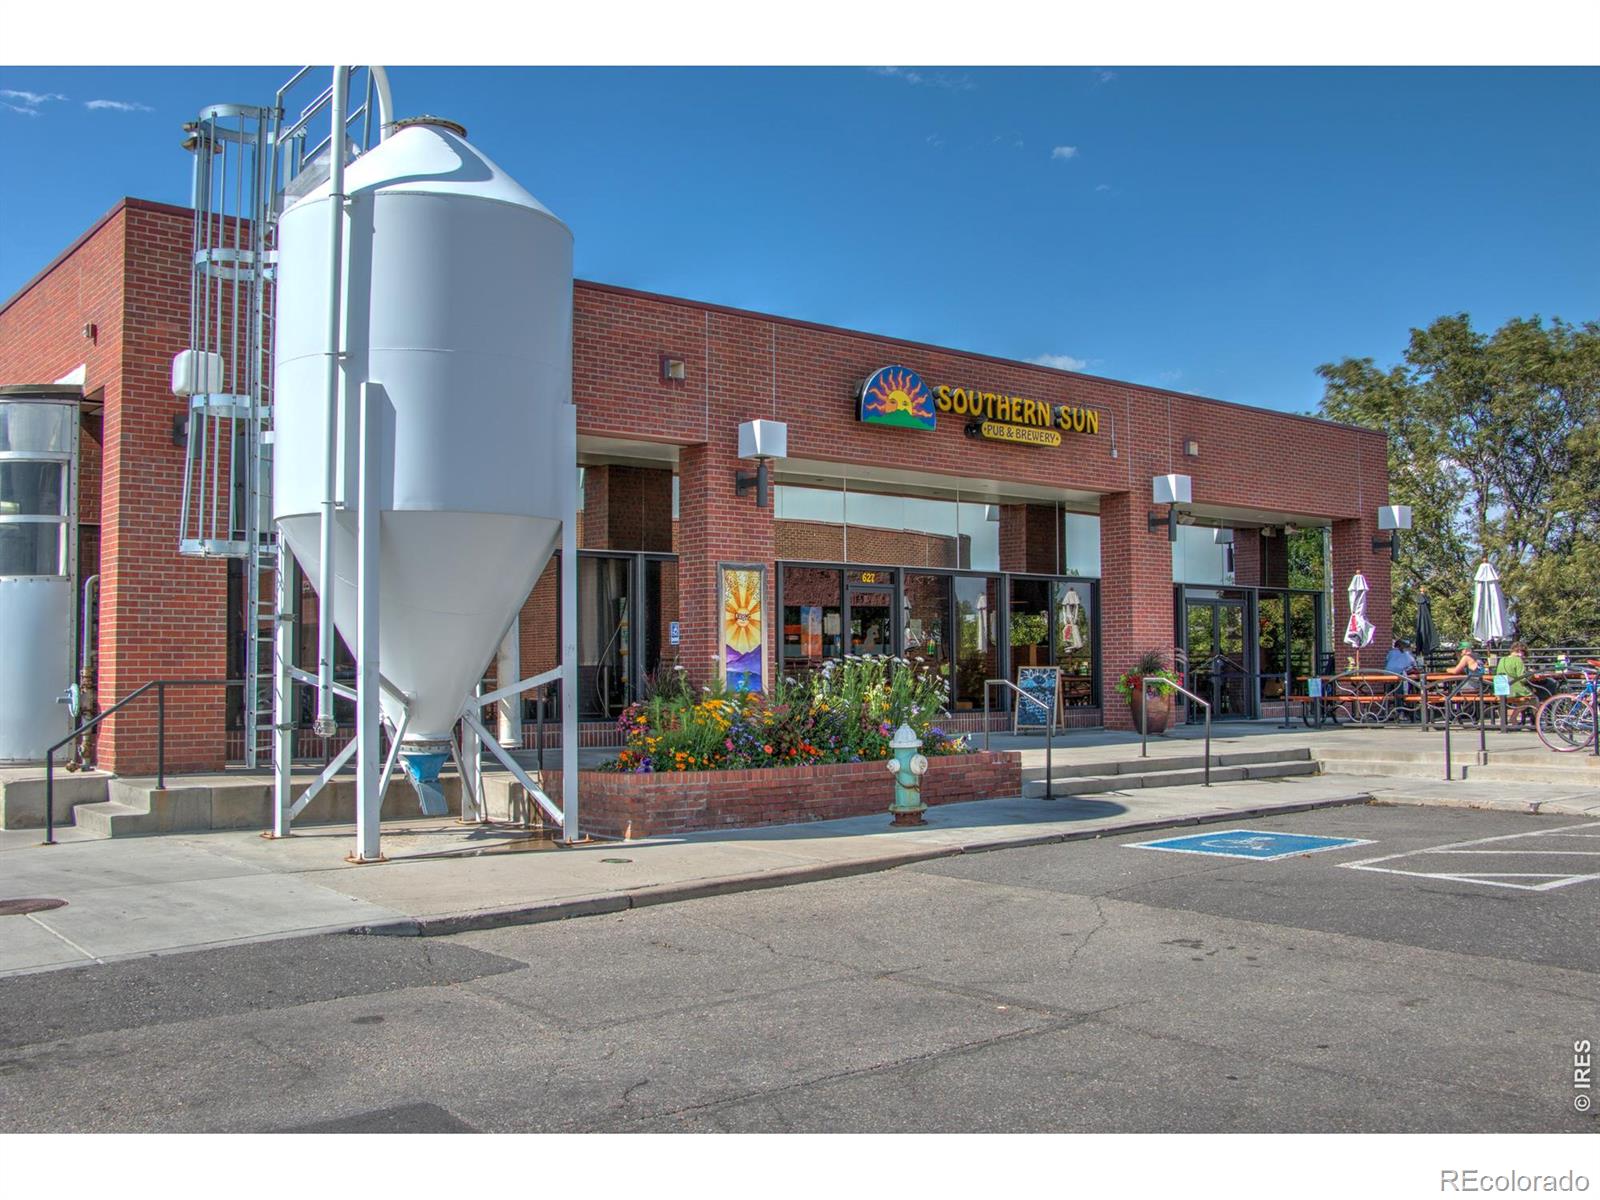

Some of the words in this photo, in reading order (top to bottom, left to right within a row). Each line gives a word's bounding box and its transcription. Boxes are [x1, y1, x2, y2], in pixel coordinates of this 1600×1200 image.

[938, 385, 1050, 427] SOUTHERN
[1059, 405, 1099, 434] SUN
[986, 425, 1005, 437] PUB
[1006, 426, 1014, 438] &
[1015, 428, 1056, 443] BREWERY
[862, 572, 875, 583] 627
